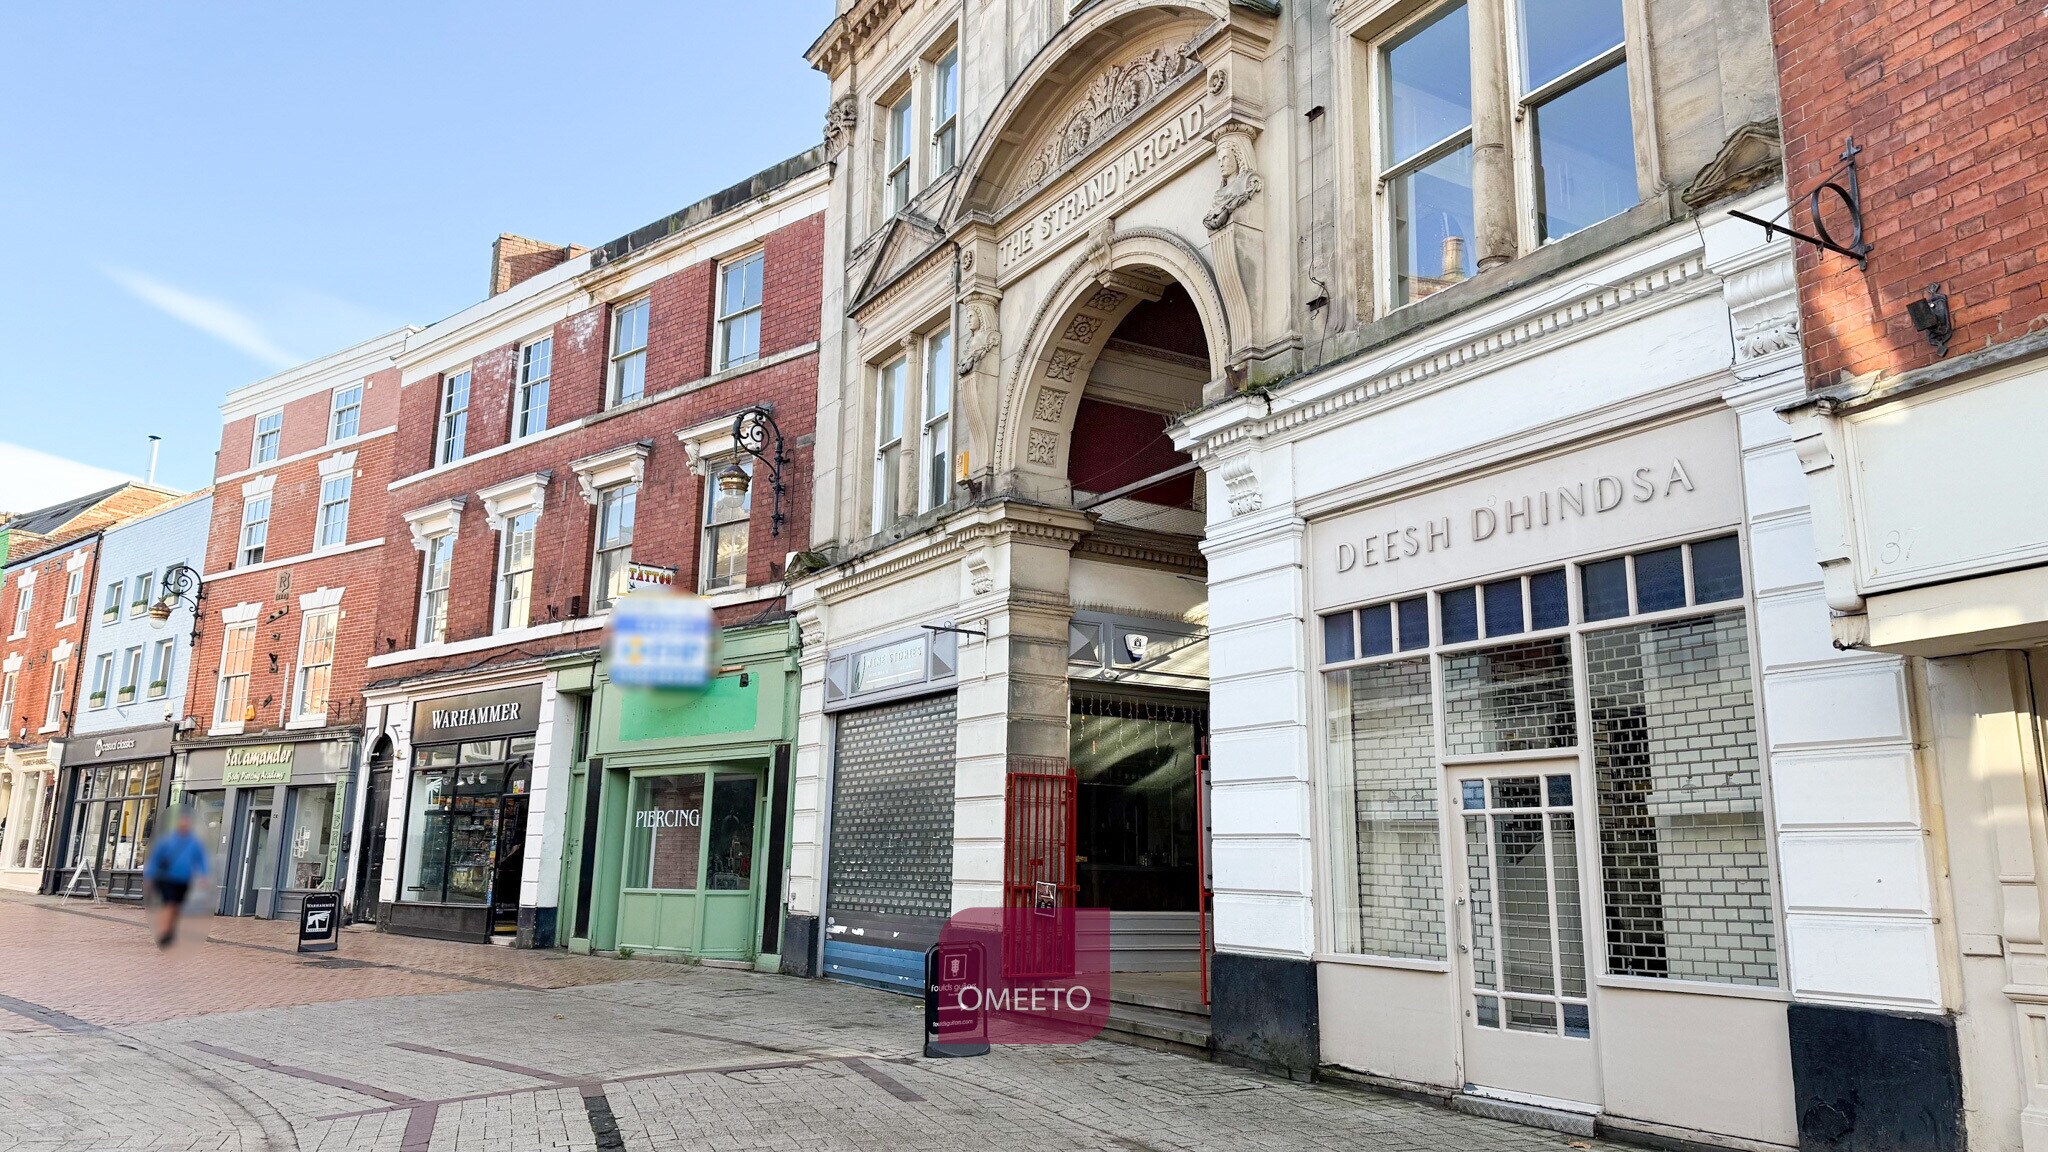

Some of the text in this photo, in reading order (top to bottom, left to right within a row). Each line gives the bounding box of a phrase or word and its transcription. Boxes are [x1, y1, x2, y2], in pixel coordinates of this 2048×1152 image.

[1000, 104, 1205, 266] THE STRAND ARCAD
[1335, 457, 1695, 573] DEESH DHINDSA
[629, 567, 672, 585] TATTOO
[866, 655, 885, 668] WINE
[890, 646, 922, 662] STORIES
[432, 702, 520, 729] WARHAMMER
[225, 744, 292, 766] Salamander
[635, 809, 700, 828] PIERCING
[931, 983, 953, 992] foulds
